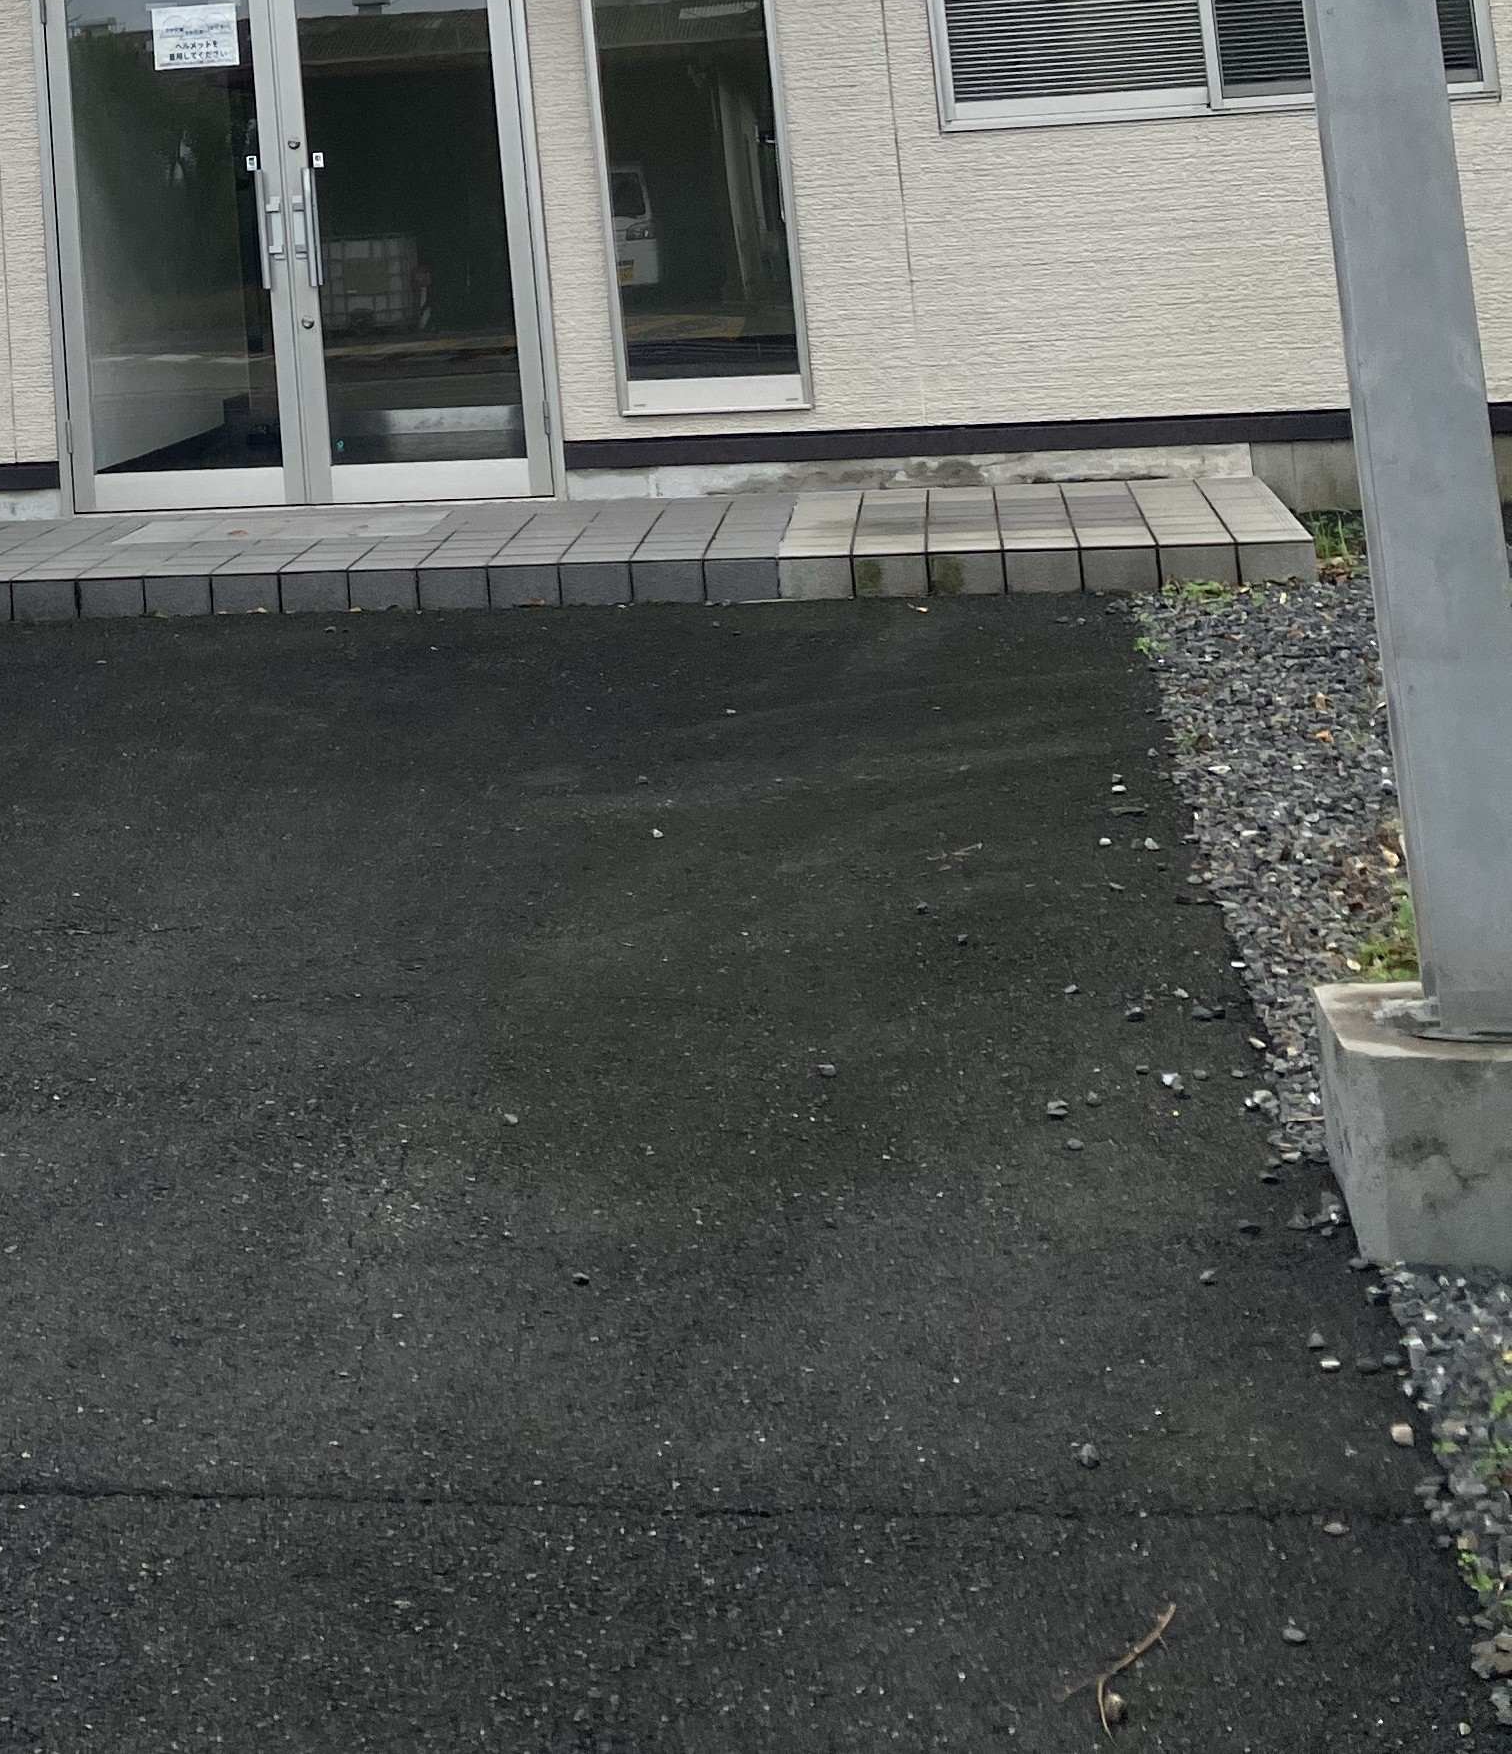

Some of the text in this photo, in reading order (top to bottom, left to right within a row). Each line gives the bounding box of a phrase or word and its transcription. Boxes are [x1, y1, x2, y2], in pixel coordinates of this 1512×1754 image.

[175, 40, 219, 50] ヘルメットを
